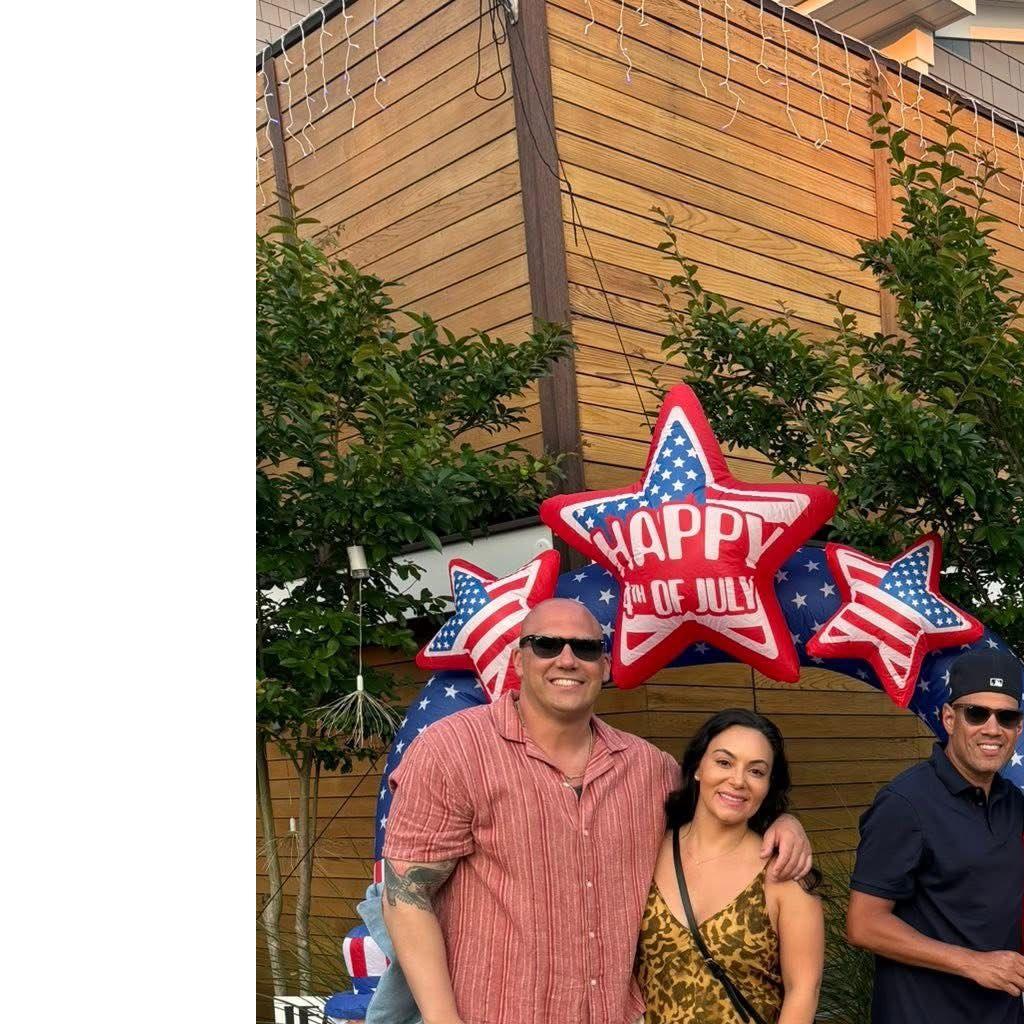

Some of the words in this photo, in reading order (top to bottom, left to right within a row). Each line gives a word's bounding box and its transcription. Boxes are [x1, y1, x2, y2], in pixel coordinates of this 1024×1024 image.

[593, 504, 784, 577] HAPPY
[623, 581, 647, 616] 4TH
[651, 579, 685, 616] OF
[695, 576, 756, 613] JULY
